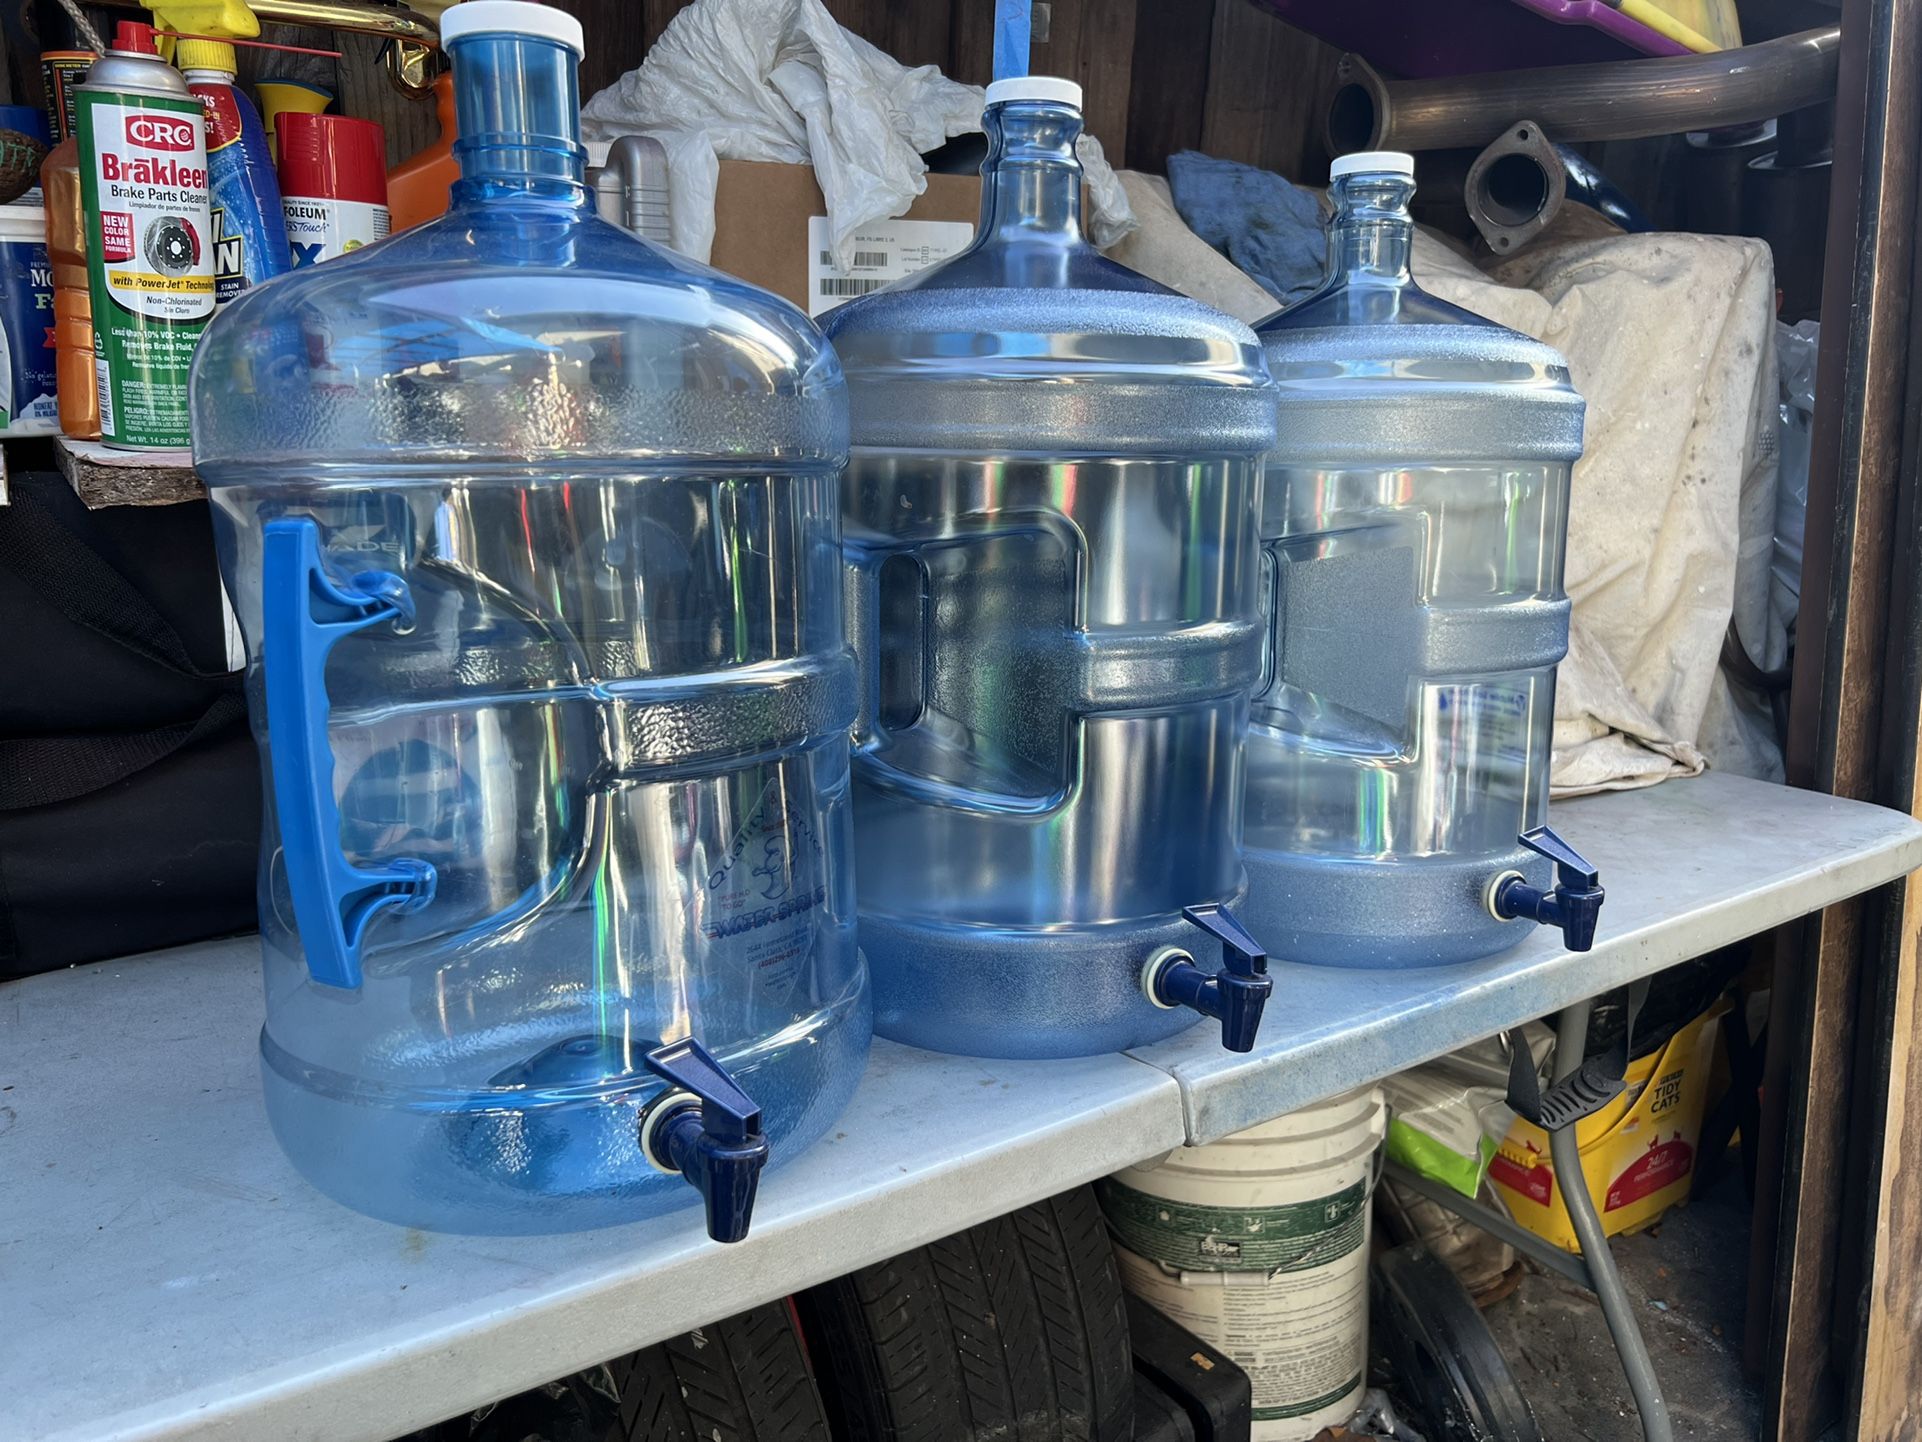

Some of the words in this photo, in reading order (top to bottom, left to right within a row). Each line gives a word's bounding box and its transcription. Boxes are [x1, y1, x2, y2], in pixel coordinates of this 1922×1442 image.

[130, 121, 191, 146] CRC
[112, 184, 144, 199] Brake
[148, 187, 177, 202] Parts
[103, 214, 129, 228] NEW
[104, 227, 129, 236] COLOR
[105, 236, 131, 247] SAME
[105, 246, 132, 254] FORMULA
[113, 276, 133, 286] with
[220, 282, 238, 292] STAIN
[146, 296, 202, 307] Non-Chlorinated
[143, 330, 159, 339] 10%
[160, 330, 175, 340] VOC
[153, 341, 174, 351] Brake
[126, 434, 136, 443] Net
[1654, 1079, 1681, 1100] TIDY
[1651, 1091, 1681, 1114] CATS
